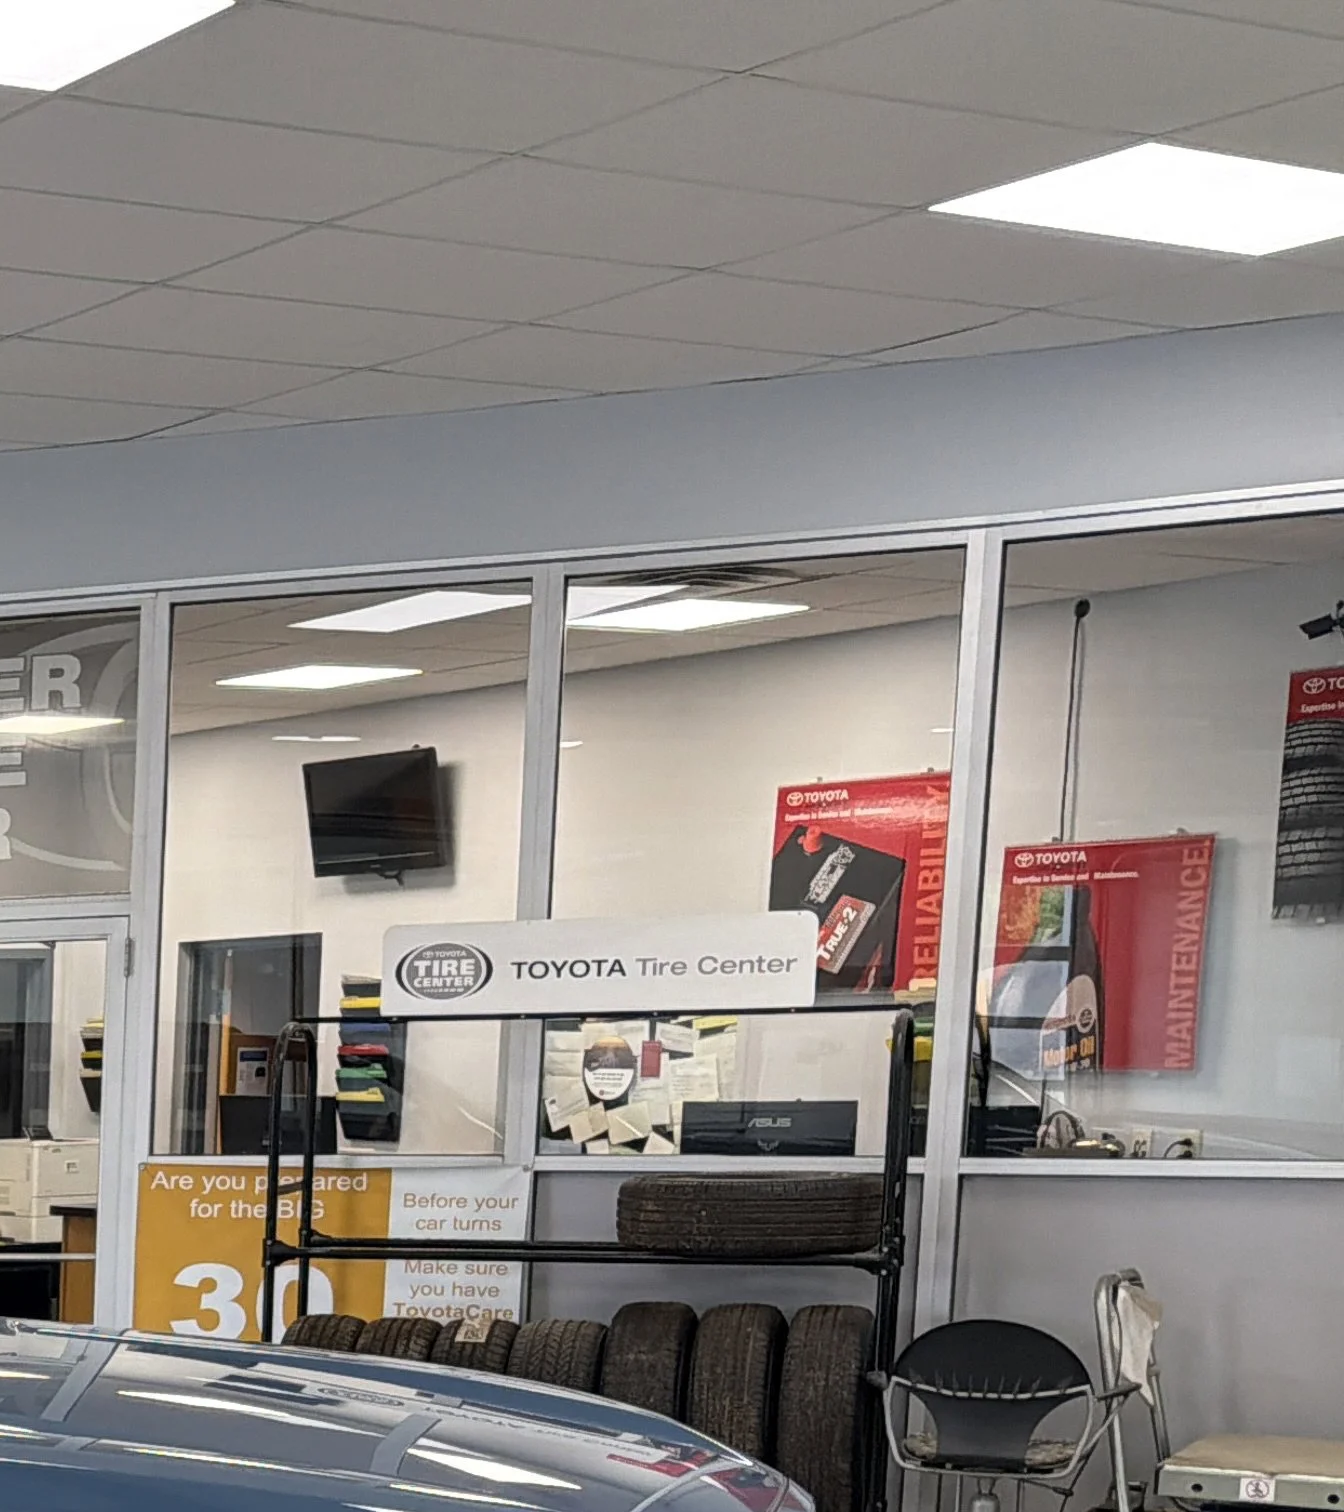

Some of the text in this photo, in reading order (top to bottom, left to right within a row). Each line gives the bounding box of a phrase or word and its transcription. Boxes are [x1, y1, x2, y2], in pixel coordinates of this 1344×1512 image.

[804, 789, 849, 802] TOYOTA
[1034, 850, 1087, 865] TOYOTA
[434, 950, 467, 958] TOYOTA
[1164, 840, 1211, 1069] MAINTENANCE.
[413, 959, 475, 977] TIRE
[510, 955, 799, 980] TOYOTA Tire Center
[413, 976, 474, 988] CENTER
[748, 1117, 793, 1128] ASUS
[150, 1170, 368, 1195] Are you peared
[190, 1198, 325, 1219] for the BIG
[403, 1192, 519, 1213] Before your
[415, 1216, 502, 1231] car turns
[404, 1260, 509, 1276] Make sure
[409, 1282, 500, 1299] you have
[392, 1302, 514, 1319] ToyotaCare
